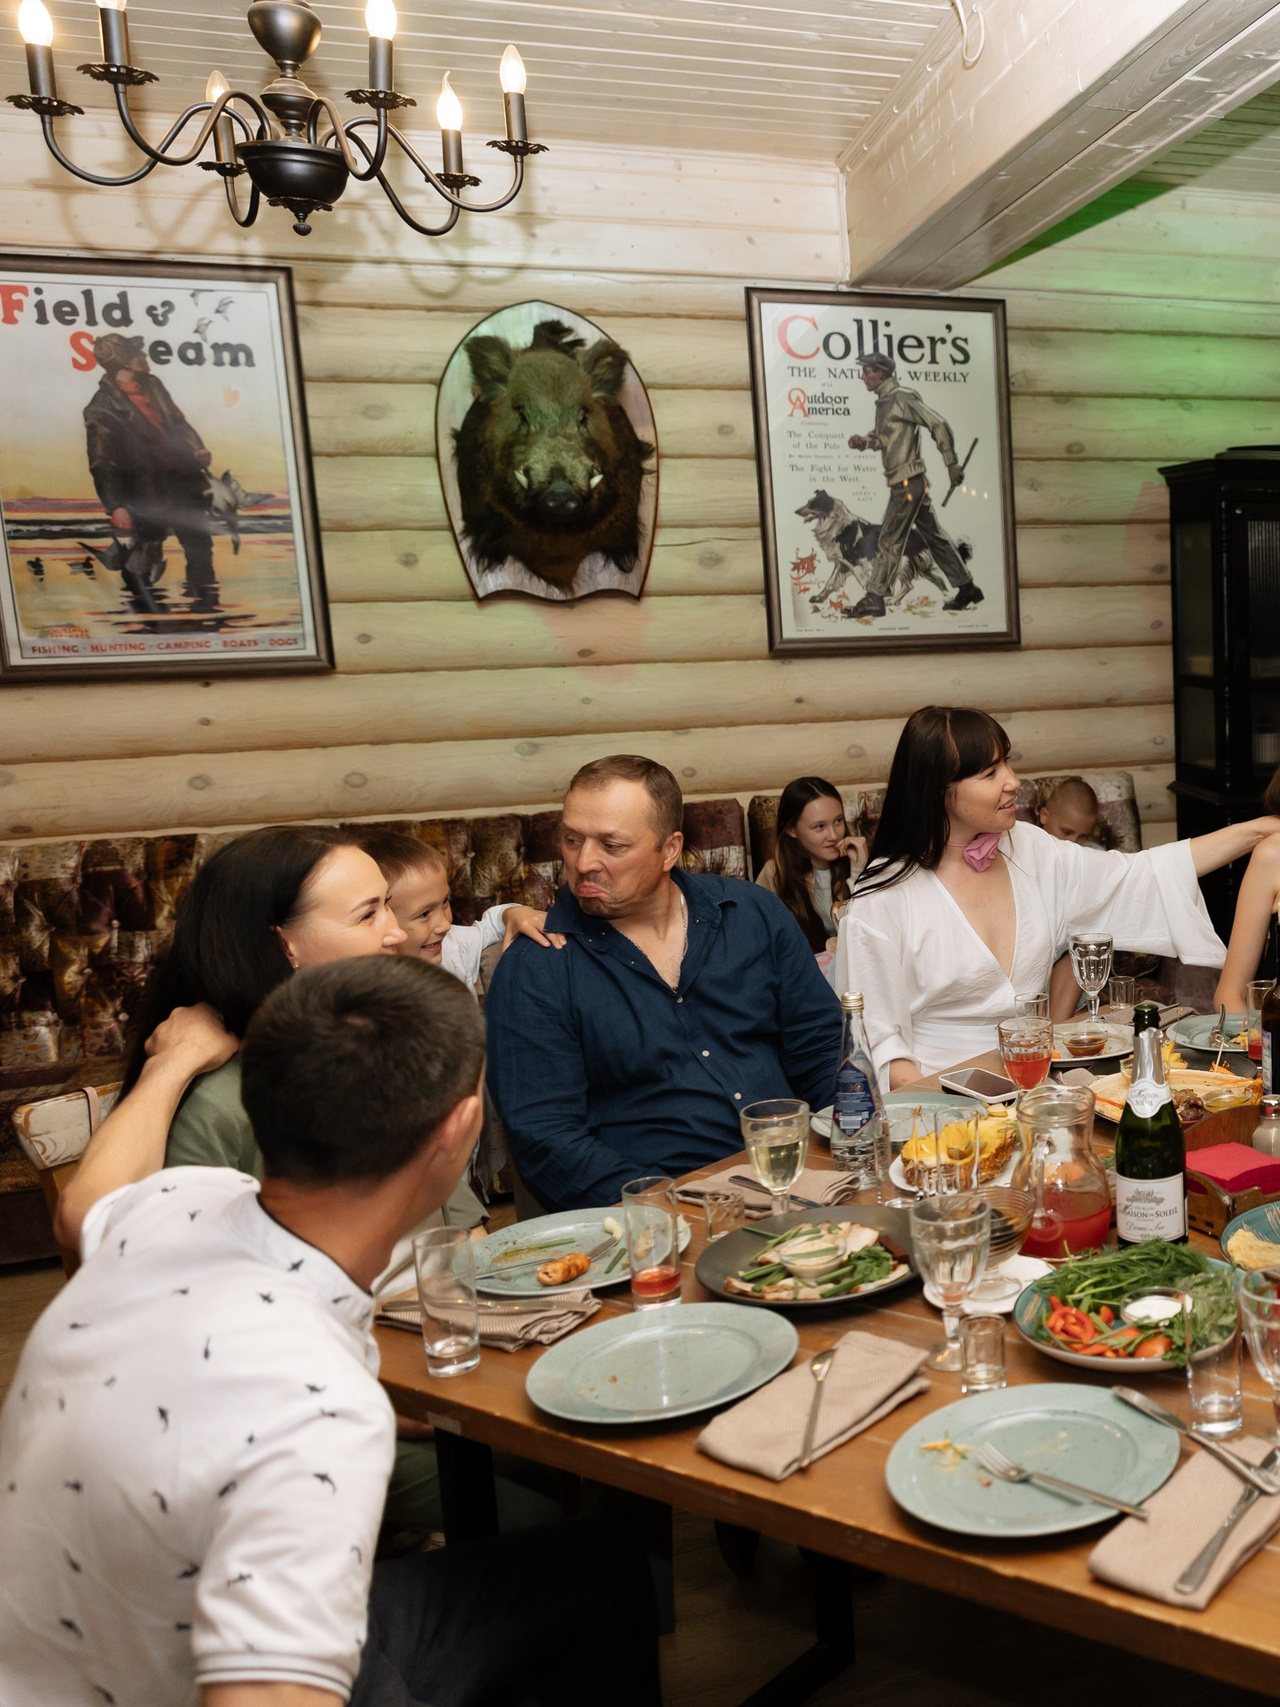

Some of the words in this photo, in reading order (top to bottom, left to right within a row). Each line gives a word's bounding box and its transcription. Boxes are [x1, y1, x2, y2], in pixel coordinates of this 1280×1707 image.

[0, 285, 134, 328] Field
[145, 300, 176, 326] &
[69, 331, 256, 371] Seam
[777, 315, 971, 366] Collier's
[787, 366, 816, 378] THE
[827, 368, 902, 381] NATIL
[907, 371, 970, 383] WEEKLY
[787, 395, 851, 418] America
[788, 387, 849, 408] Outdoor
[787, 430, 802, 438] The
[808, 431, 844, 441] Conquest
[789, 464, 804, 472] The
[811, 464, 831, 473] Fight
[853, 464, 877, 472] Water
[31, 644, 79, 655] FISHING
[90, 642, 145, 653] HUNTING
[156, 640, 211, 651] CAMPING
[222, 638, 258, 649] BOATS
[269, 637, 299, 647] DOGS
